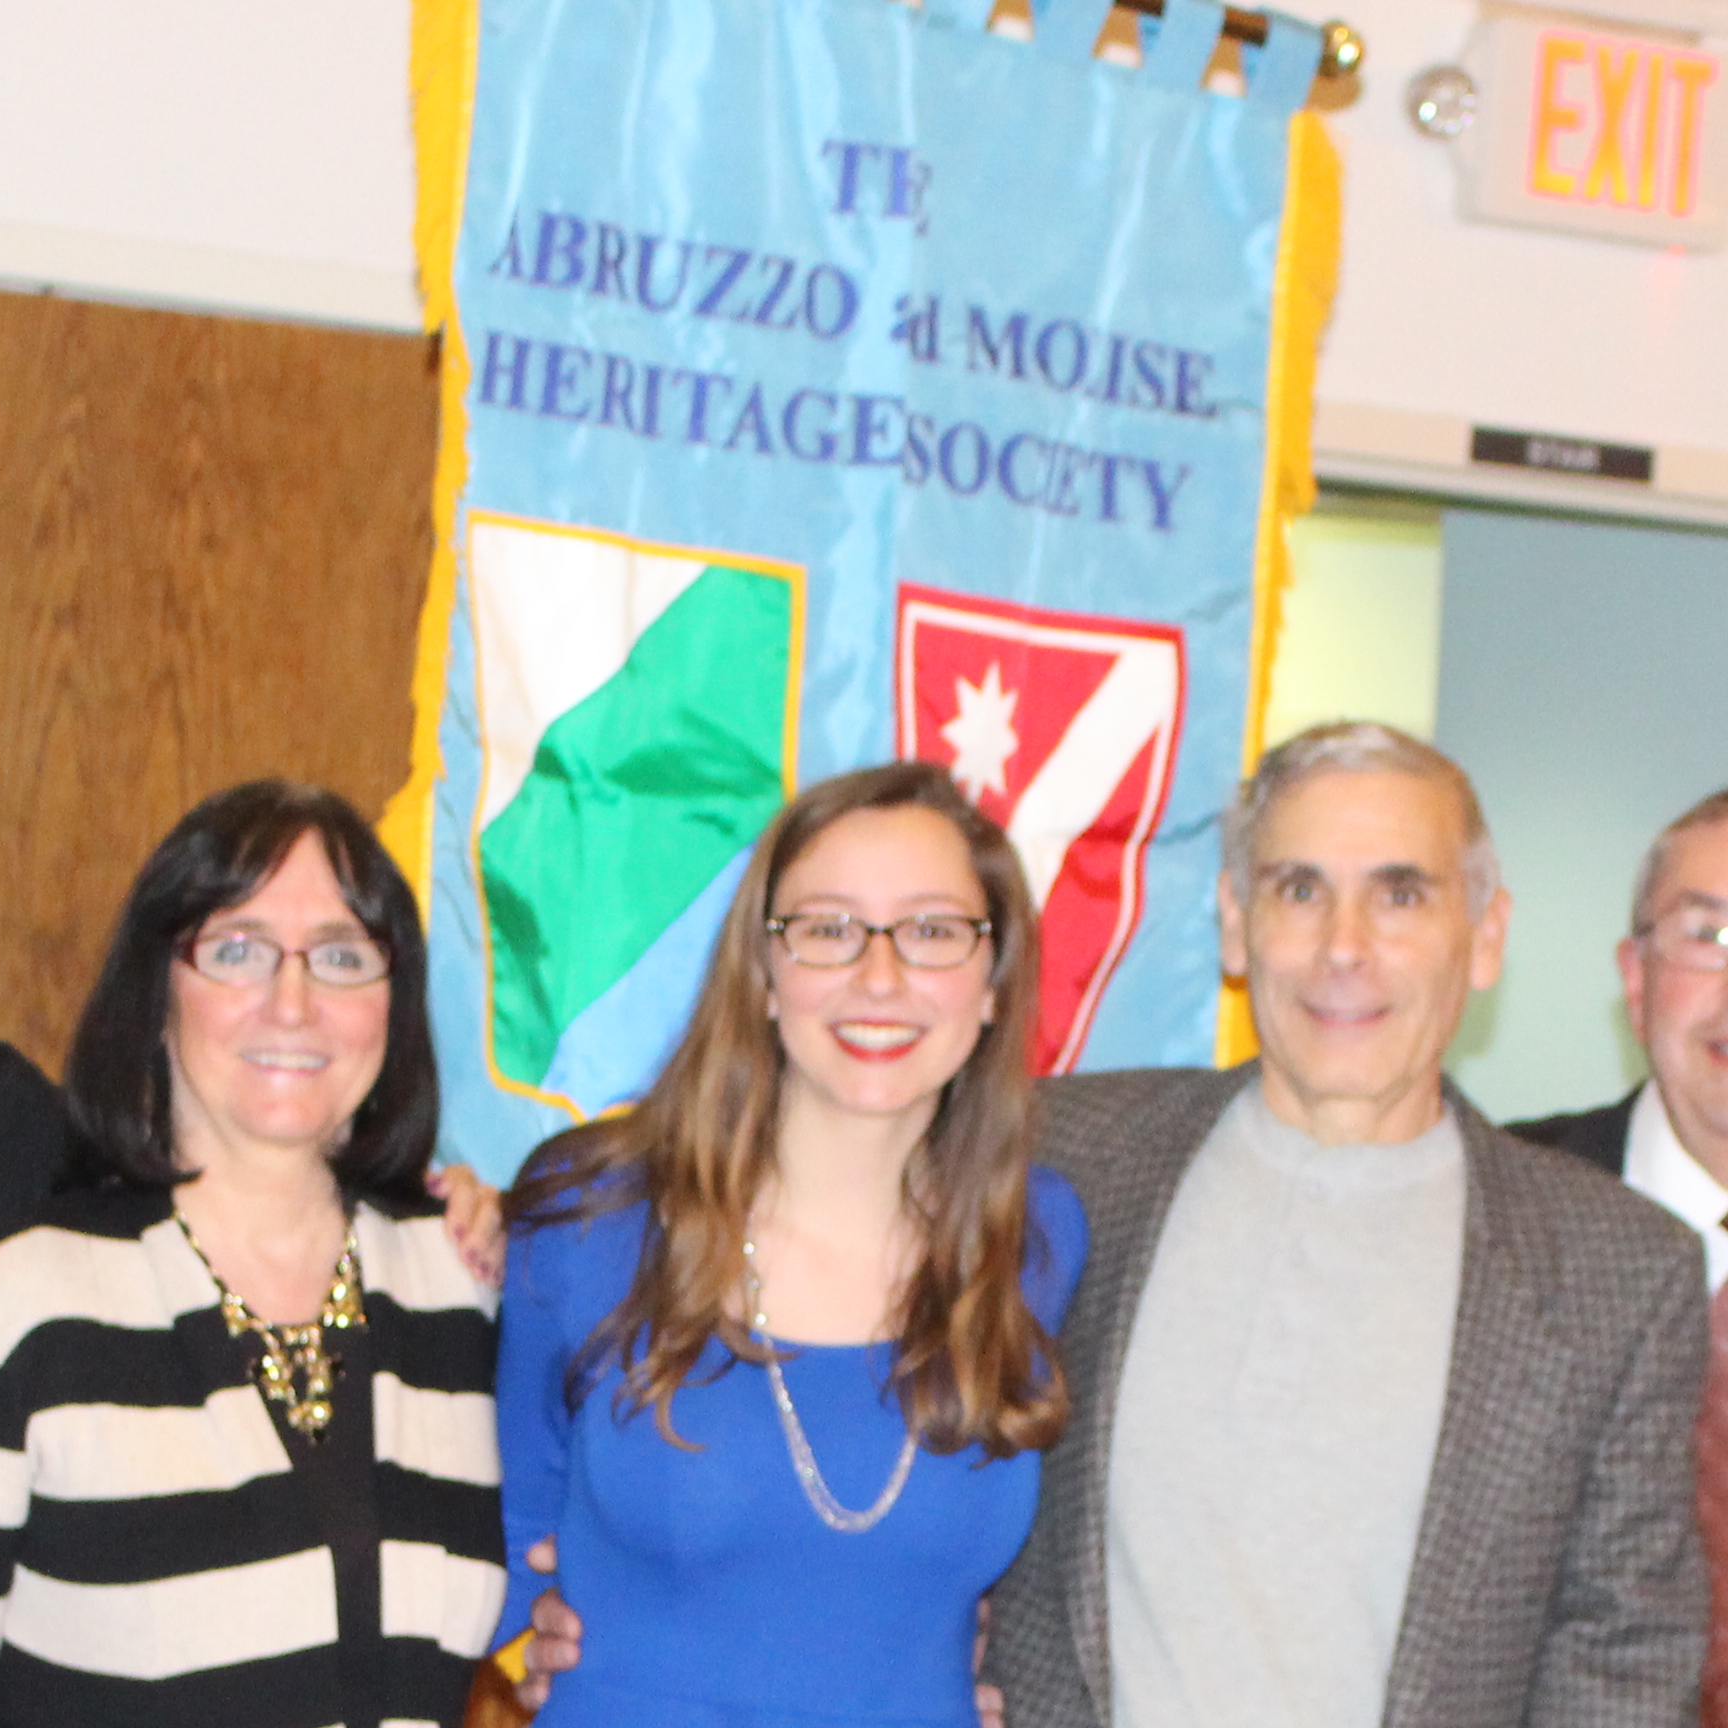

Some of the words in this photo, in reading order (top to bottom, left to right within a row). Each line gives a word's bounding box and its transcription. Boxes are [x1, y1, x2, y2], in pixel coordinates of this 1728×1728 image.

[1528, 34, 1720, 216] EXIT
[479, 327, 908, 468] HERITAGE
[487, 203, 863, 342] ABRUZZO
[966, 302, 1218, 421] MOISE
